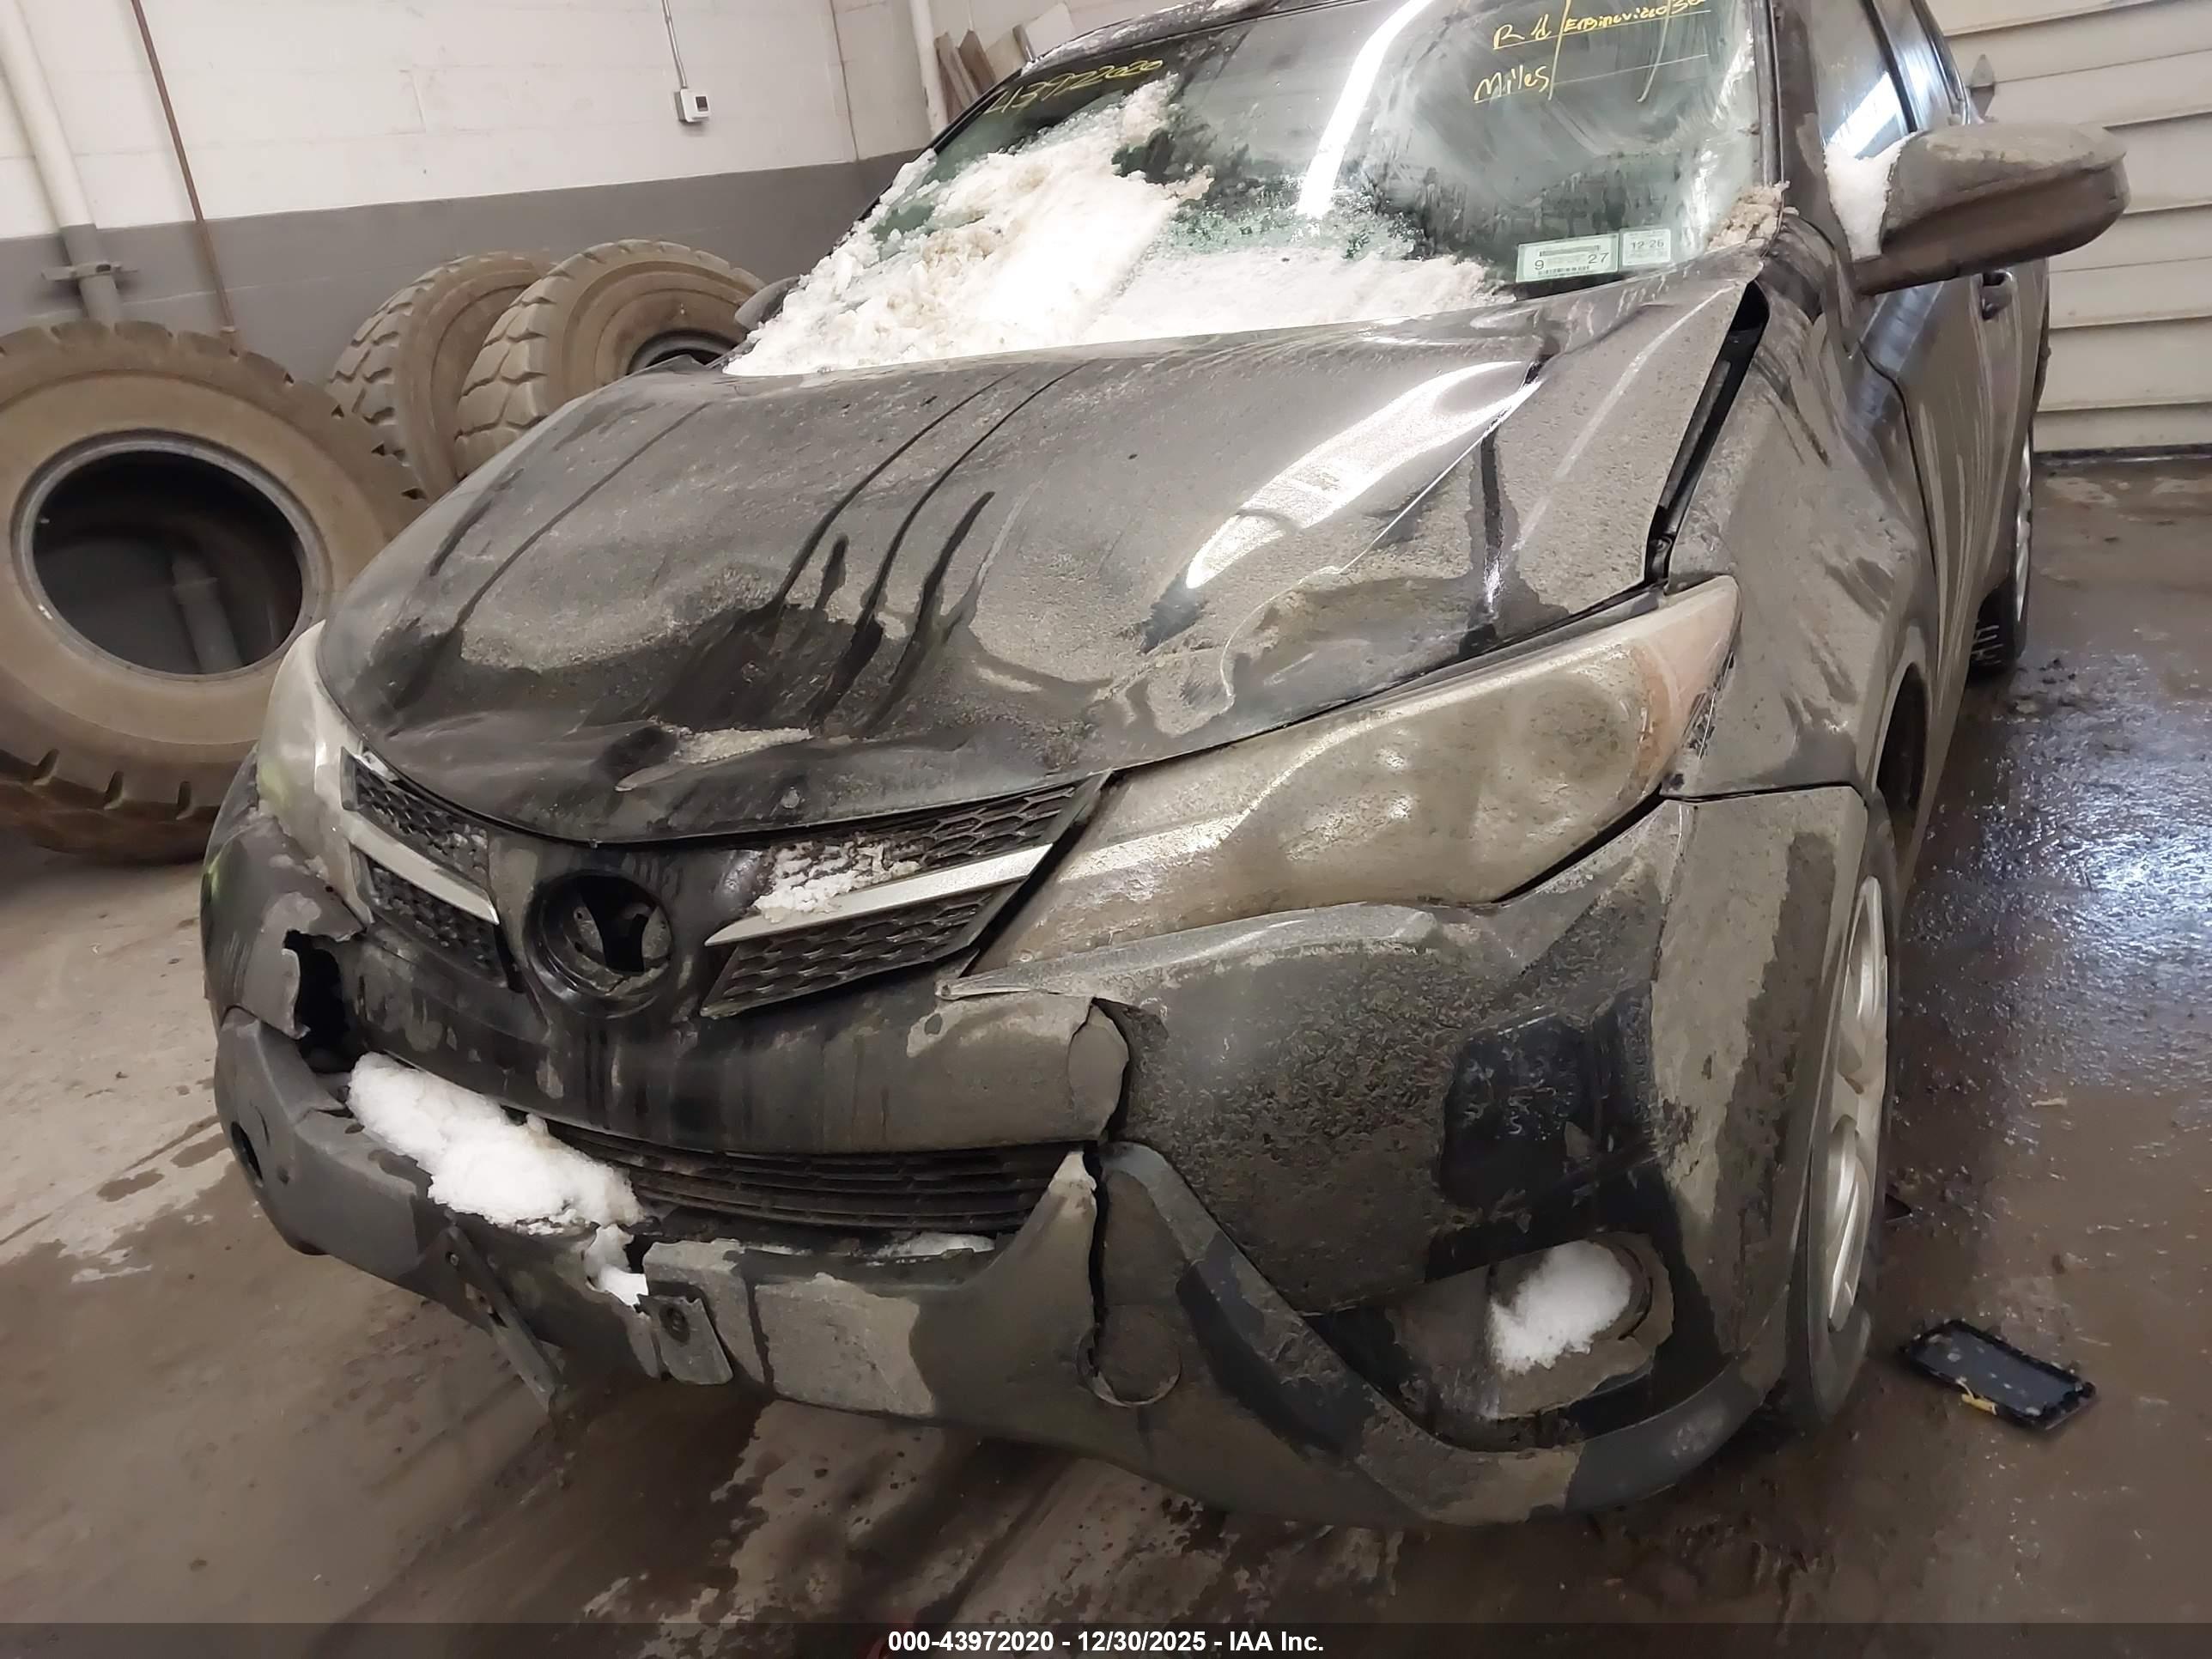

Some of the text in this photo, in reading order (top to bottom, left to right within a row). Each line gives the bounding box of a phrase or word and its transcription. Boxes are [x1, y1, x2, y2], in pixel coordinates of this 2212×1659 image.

[1474, 64, 1550, 100] Miles
[1534, 252, 1609, 270] 9 27
